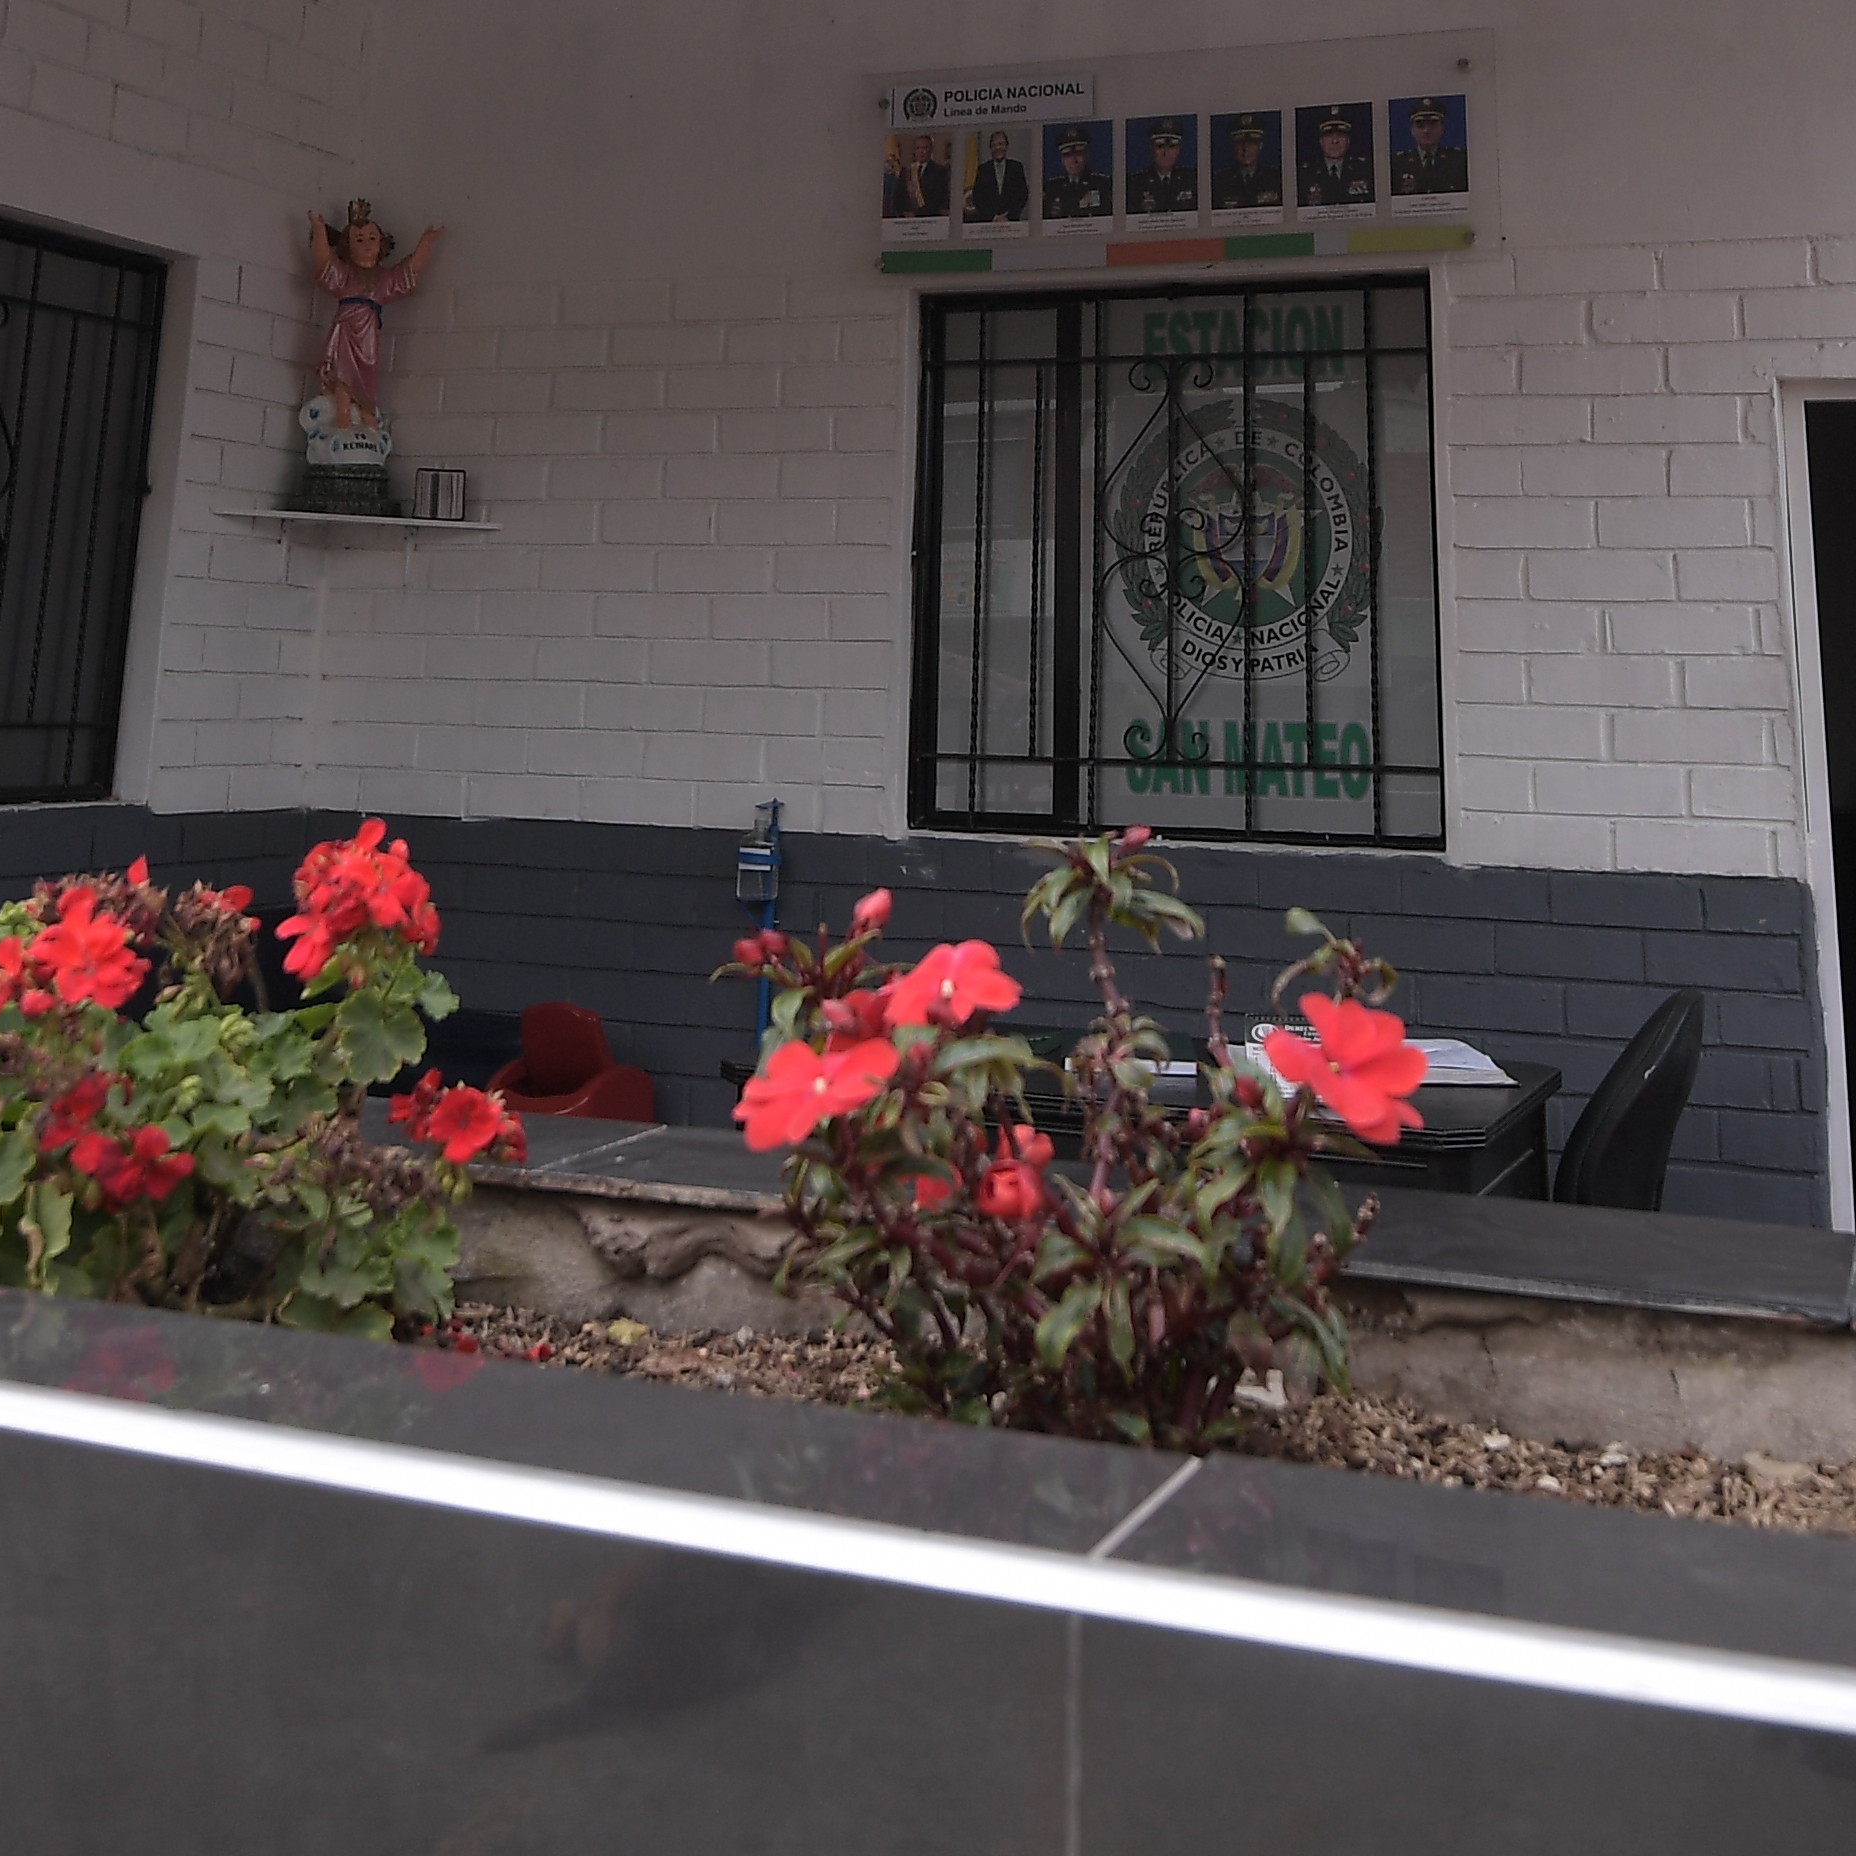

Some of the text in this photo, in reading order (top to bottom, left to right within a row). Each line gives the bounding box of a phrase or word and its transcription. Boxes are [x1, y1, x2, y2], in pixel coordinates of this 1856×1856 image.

[944, 82, 1085, 103] POLICIA NACIONAL
[975, 106, 989, 115] de
[991, 104, 1028, 114] Mando
[1143, 305, 1344, 380] ESTACION
[1284, 442, 1349, 553] COLOMBIA
[1161, 579, 1341, 646] OLICIA NACIONAL
[1181, 639, 1228, 671] DIOS
[1125, 718, 1370, 799] SAN MATEO
